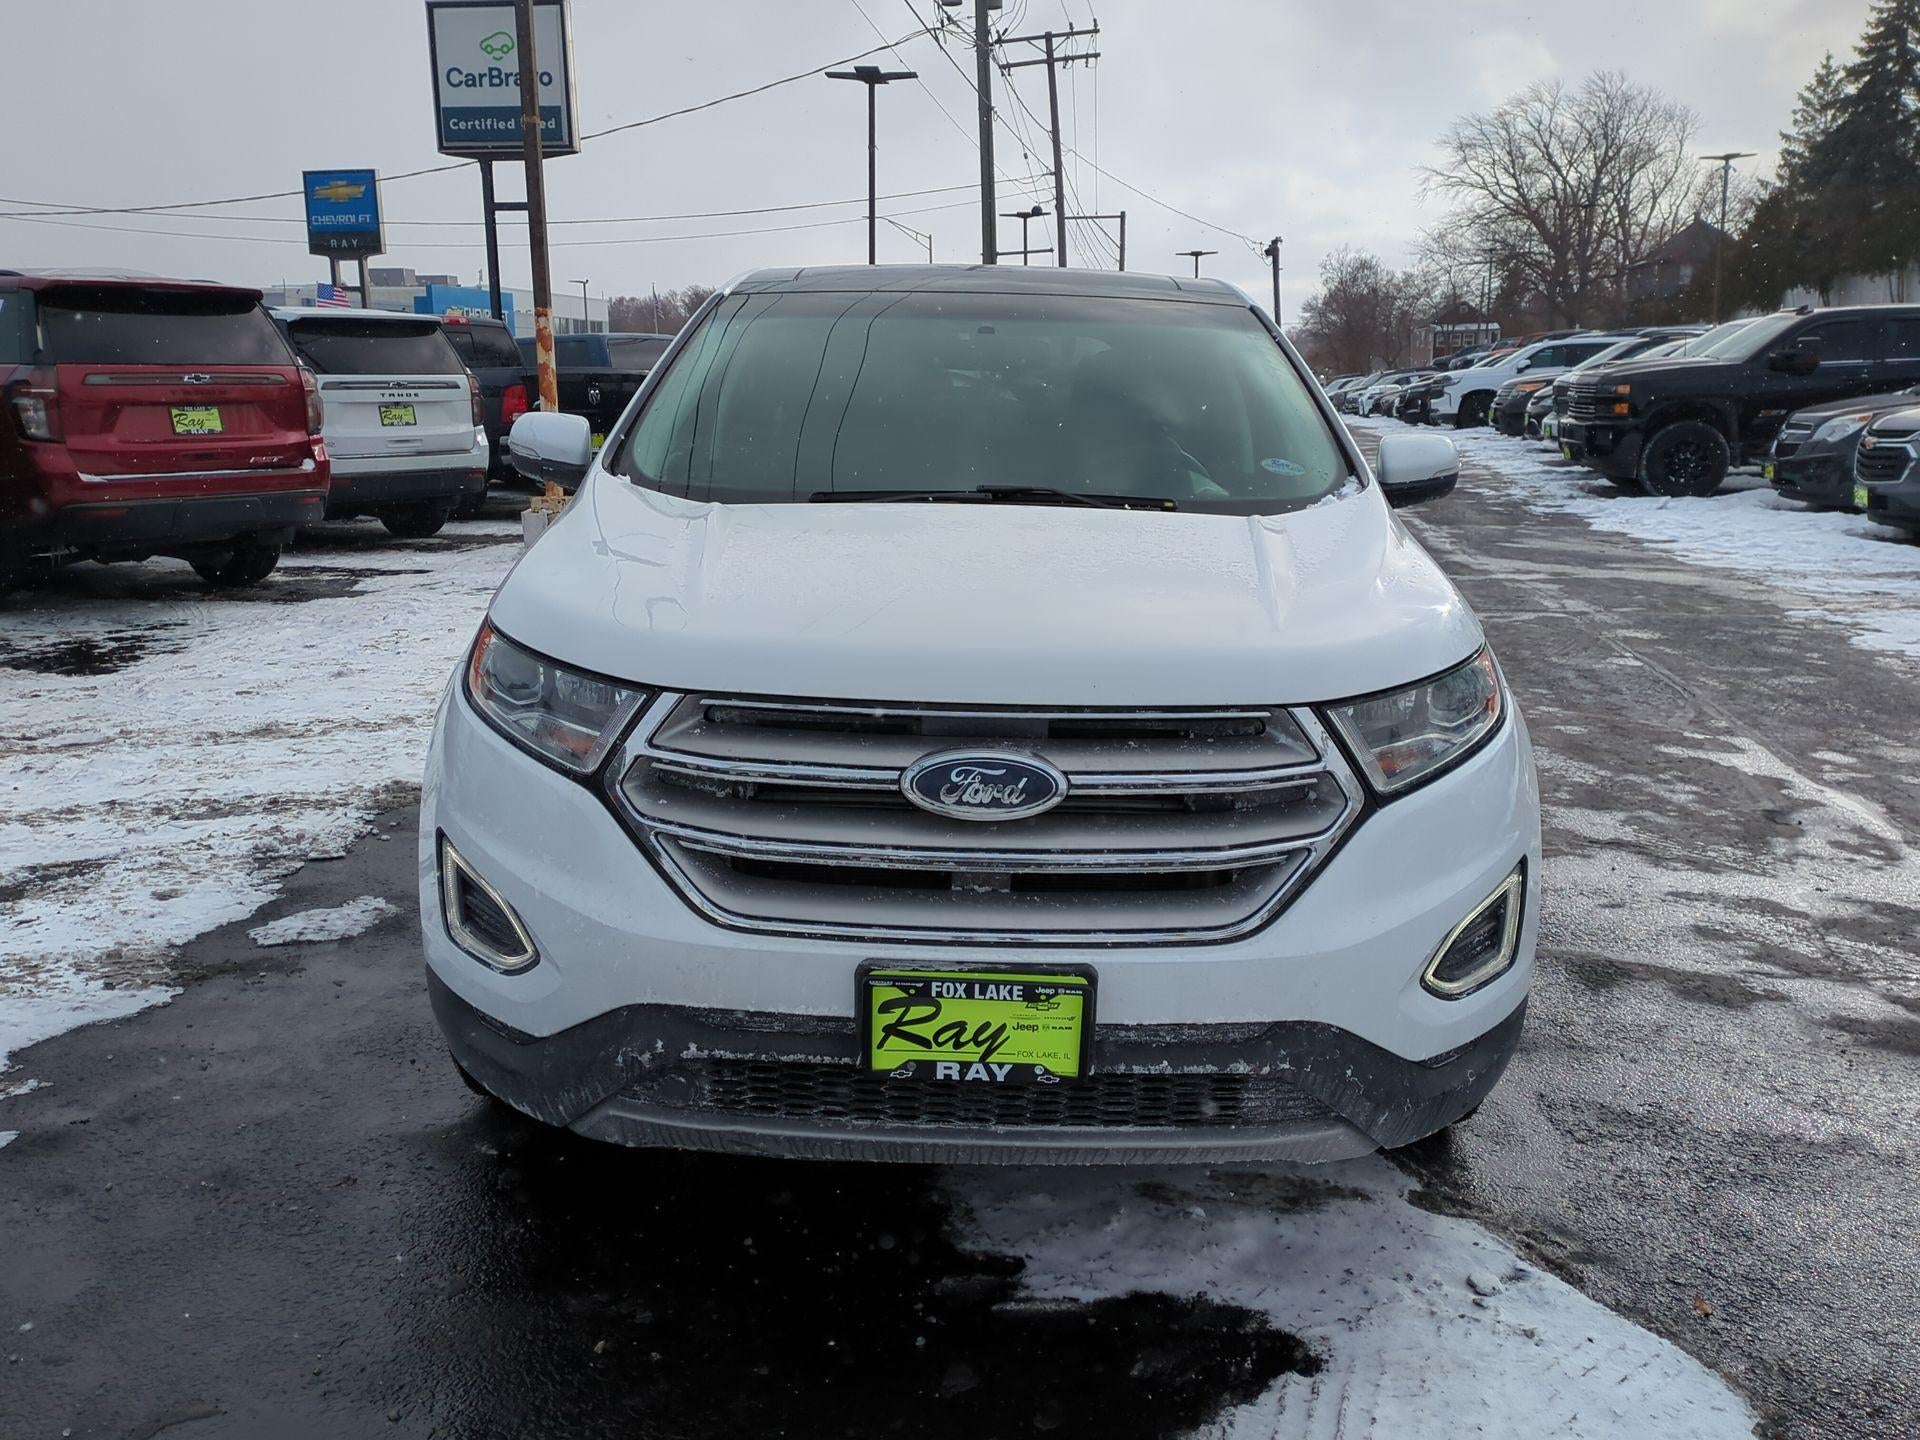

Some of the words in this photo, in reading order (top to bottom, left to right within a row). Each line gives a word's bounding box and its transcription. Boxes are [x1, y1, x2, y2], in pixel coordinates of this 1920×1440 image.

[446, 66, 553, 88] CarBrao
[449, 118, 515, 130] Certified
[312, 214, 372, 225] CHEVROLET
[330, 239, 358, 248] RAY
[173, 413, 206, 429] Ray
[940, 766, 1028, 804] Ford
[931, 981, 967, 999] FOX
[974, 983, 1024, 1001] LAKE
[1035, 987, 1055, 995] Jeep
[876, 996, 1011, 1062] Ray
[1012, 1022, 1039, 1032] Jeep
[1016, 1050, 1034, 1058] FOX
[1036, 1051, 1061, 1060] LAKE,
[1063, 1052, 1071, 1060] IL
[936, 1061, 1014, 1082] RAY
